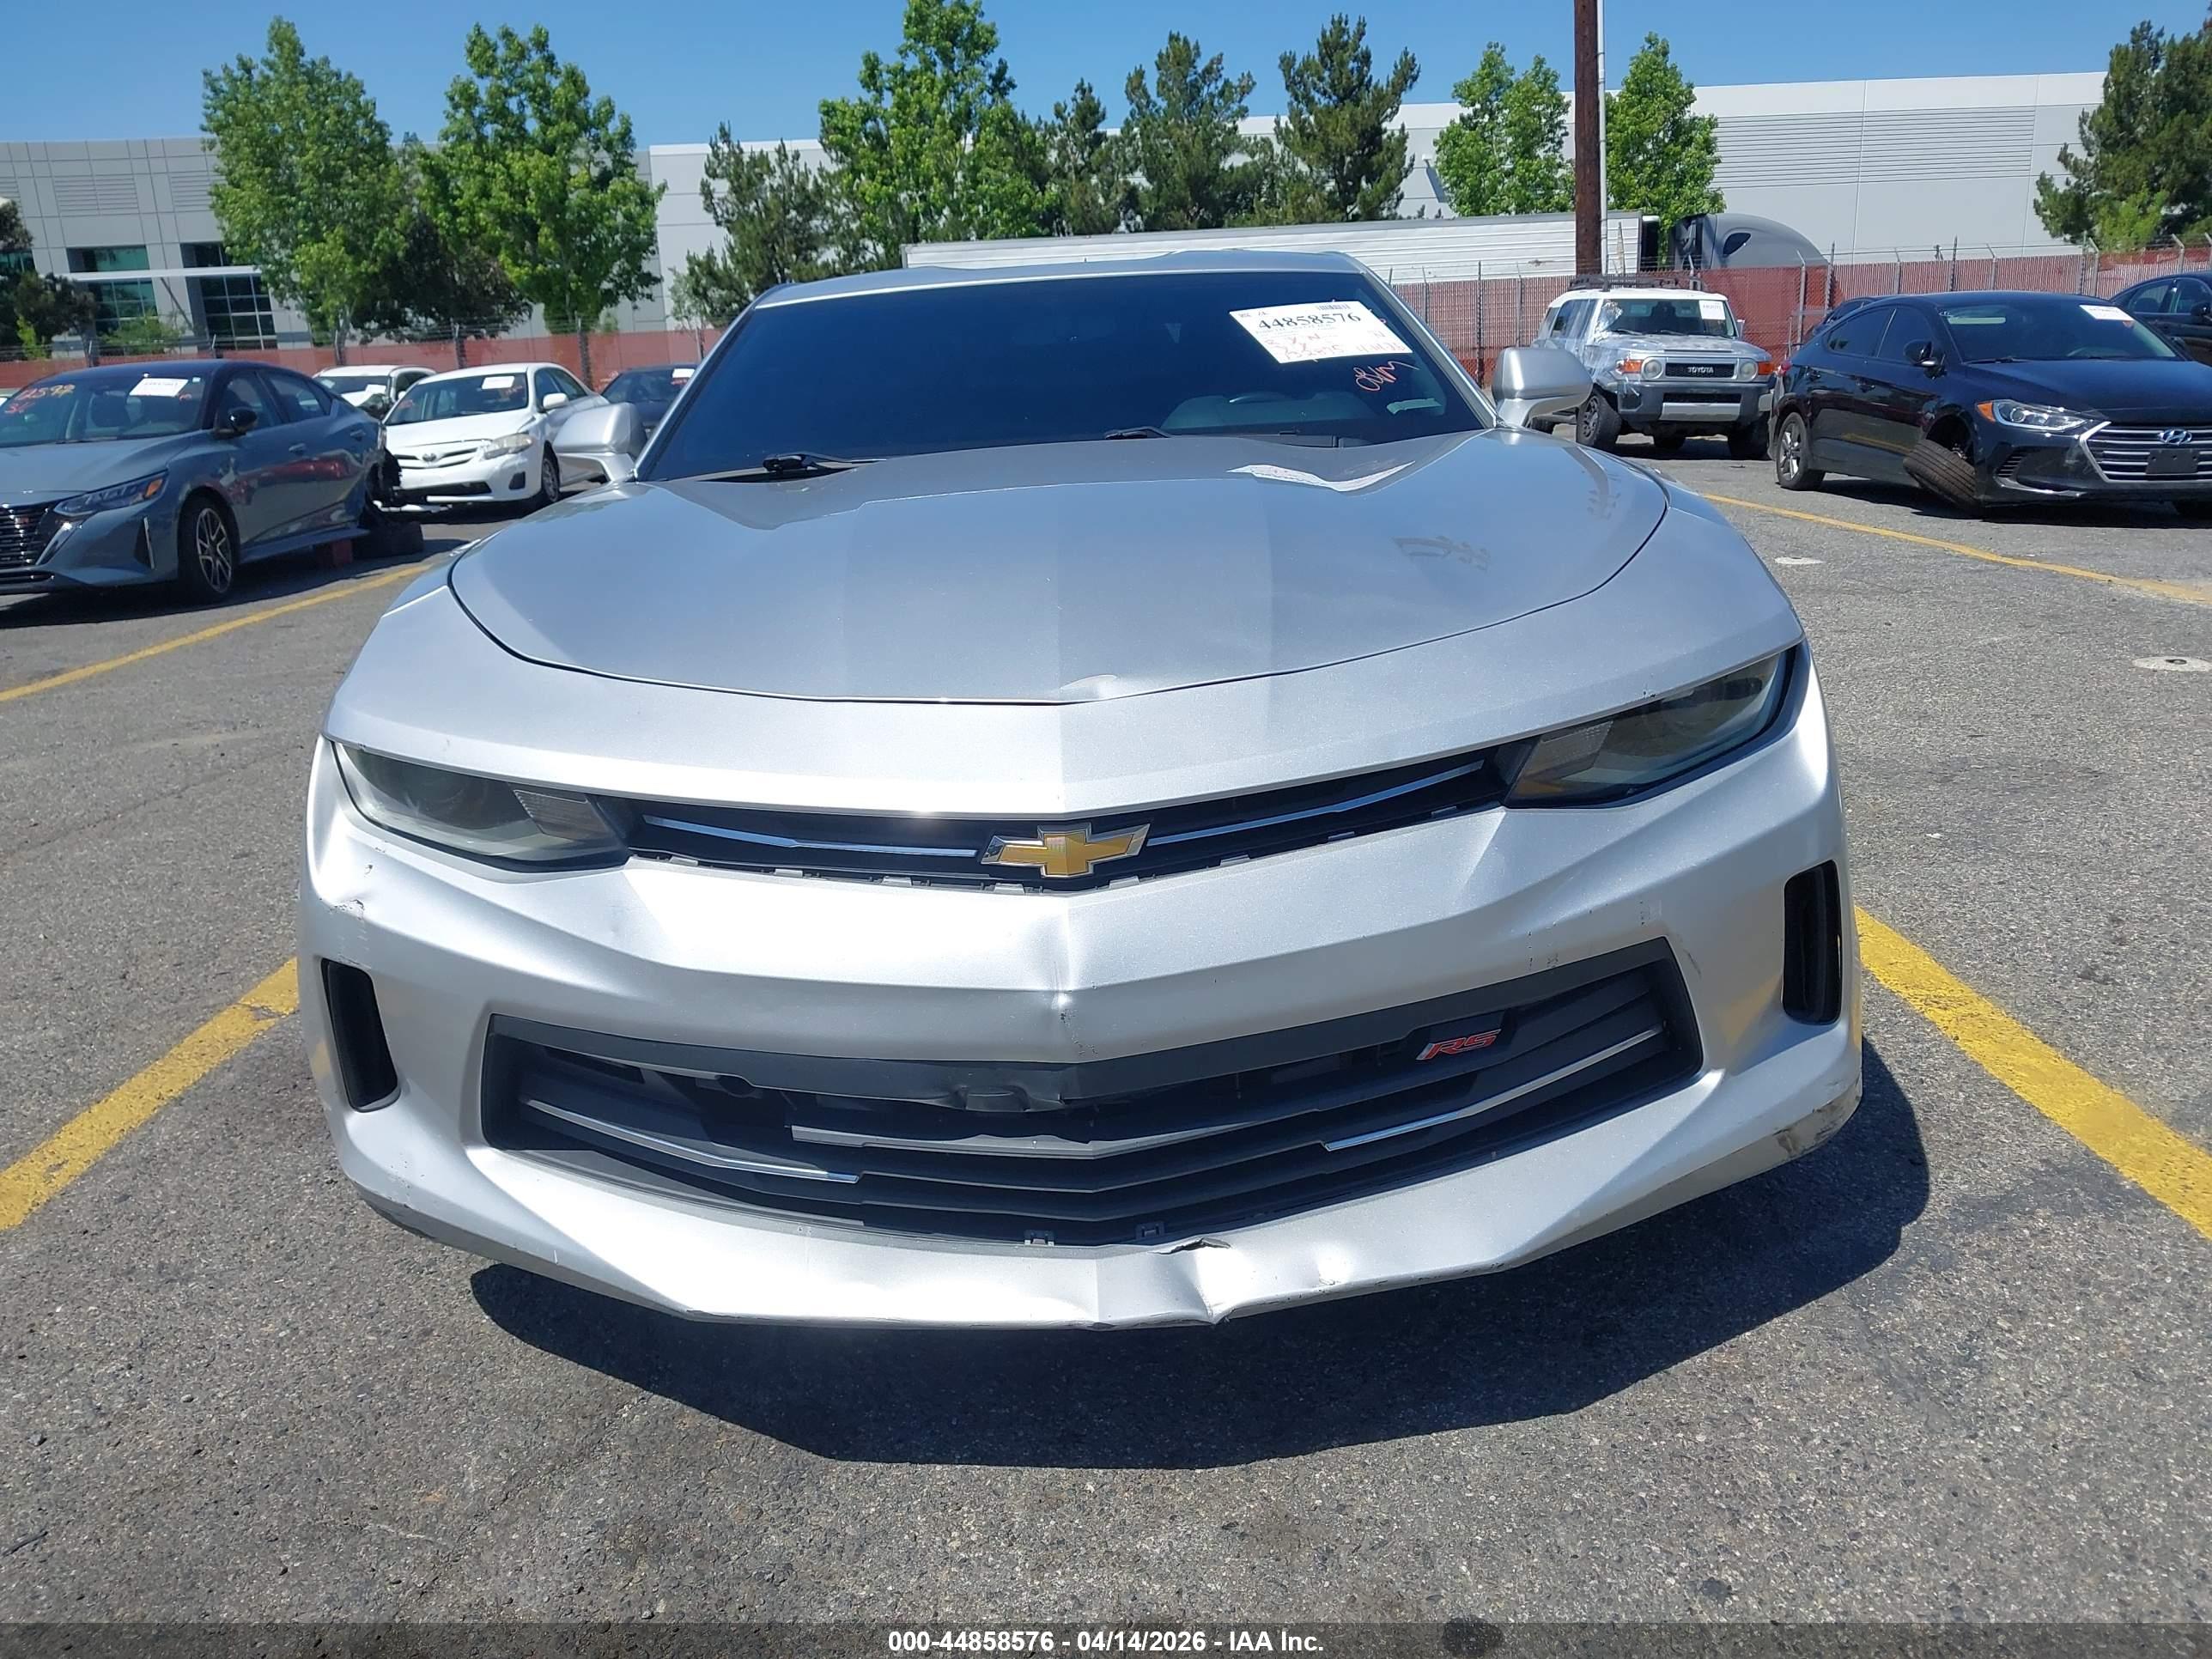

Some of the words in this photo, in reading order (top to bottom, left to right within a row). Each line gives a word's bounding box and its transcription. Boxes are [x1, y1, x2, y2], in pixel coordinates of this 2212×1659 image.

[1259, 312, 1362, 329] 44858576
[1687, 366, 1714, 374] TOYOTA
[1417, 1029, 1501, 1060] RS
